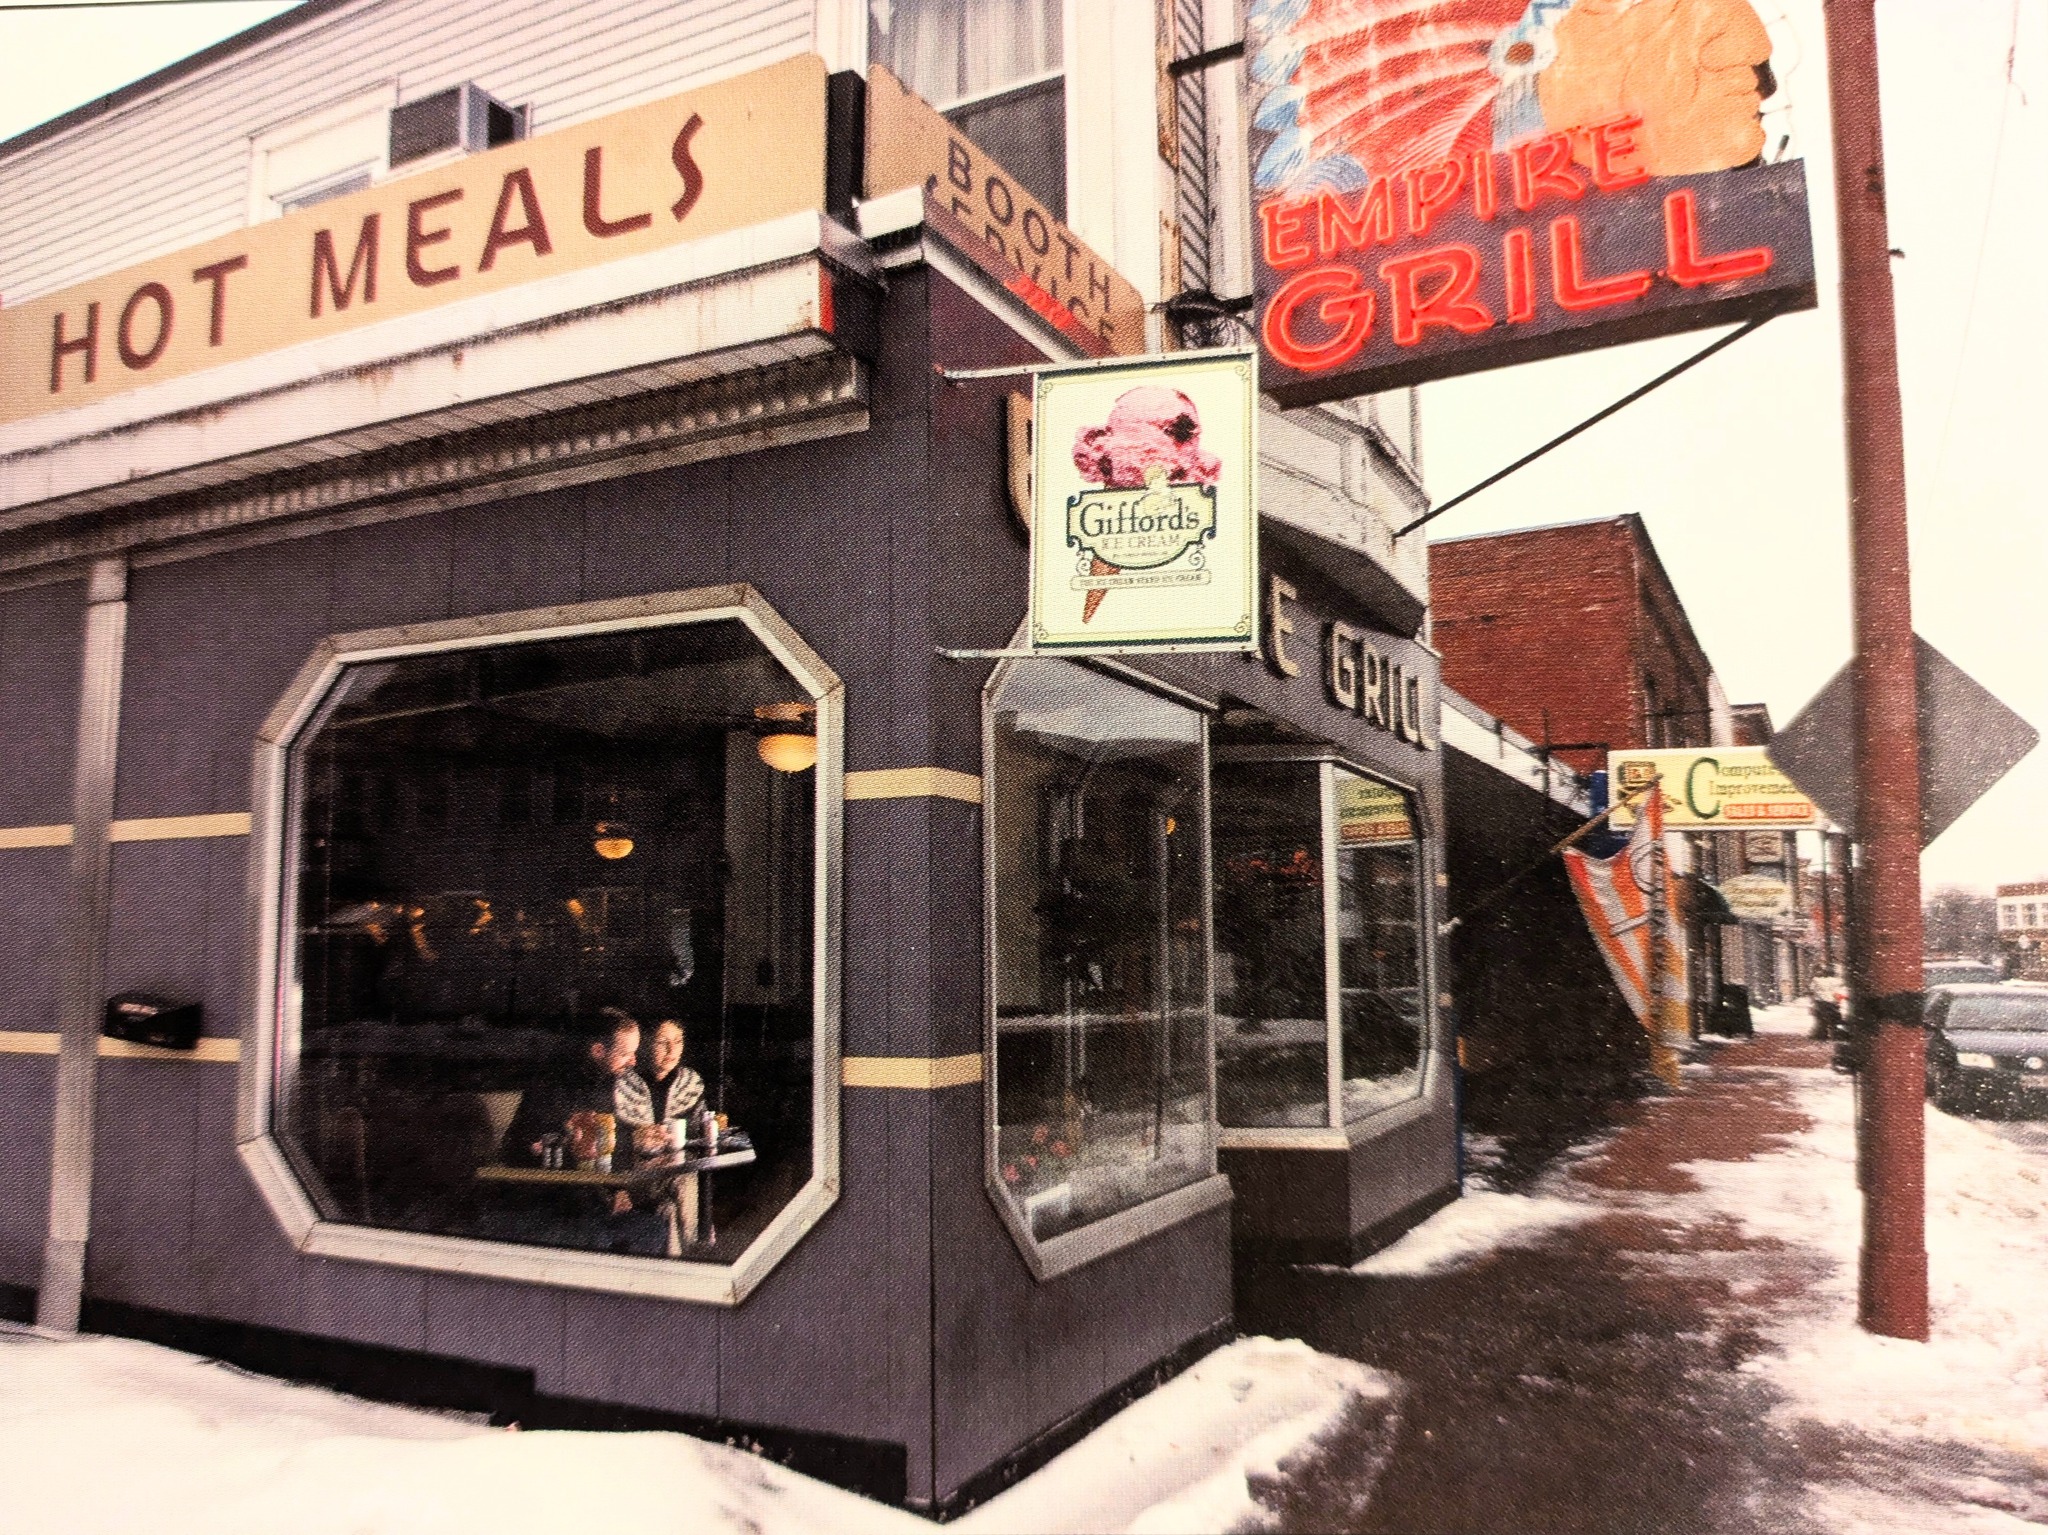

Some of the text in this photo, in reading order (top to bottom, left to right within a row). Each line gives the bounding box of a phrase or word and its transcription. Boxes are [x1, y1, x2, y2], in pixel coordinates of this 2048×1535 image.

[49, 112, 705, 395] HOT MEALS
[947, 136, 1111, 313] BOOTH
[1259, 113, 1651, 269] EMPIRE
[1262, 188, 1773, 372] GRILL
[1101, 534, 1180, 550] ICE CREAM
[1331, 618, 1438, 751] GRILL
[1709, 780, 1798, 798] Improvemen
